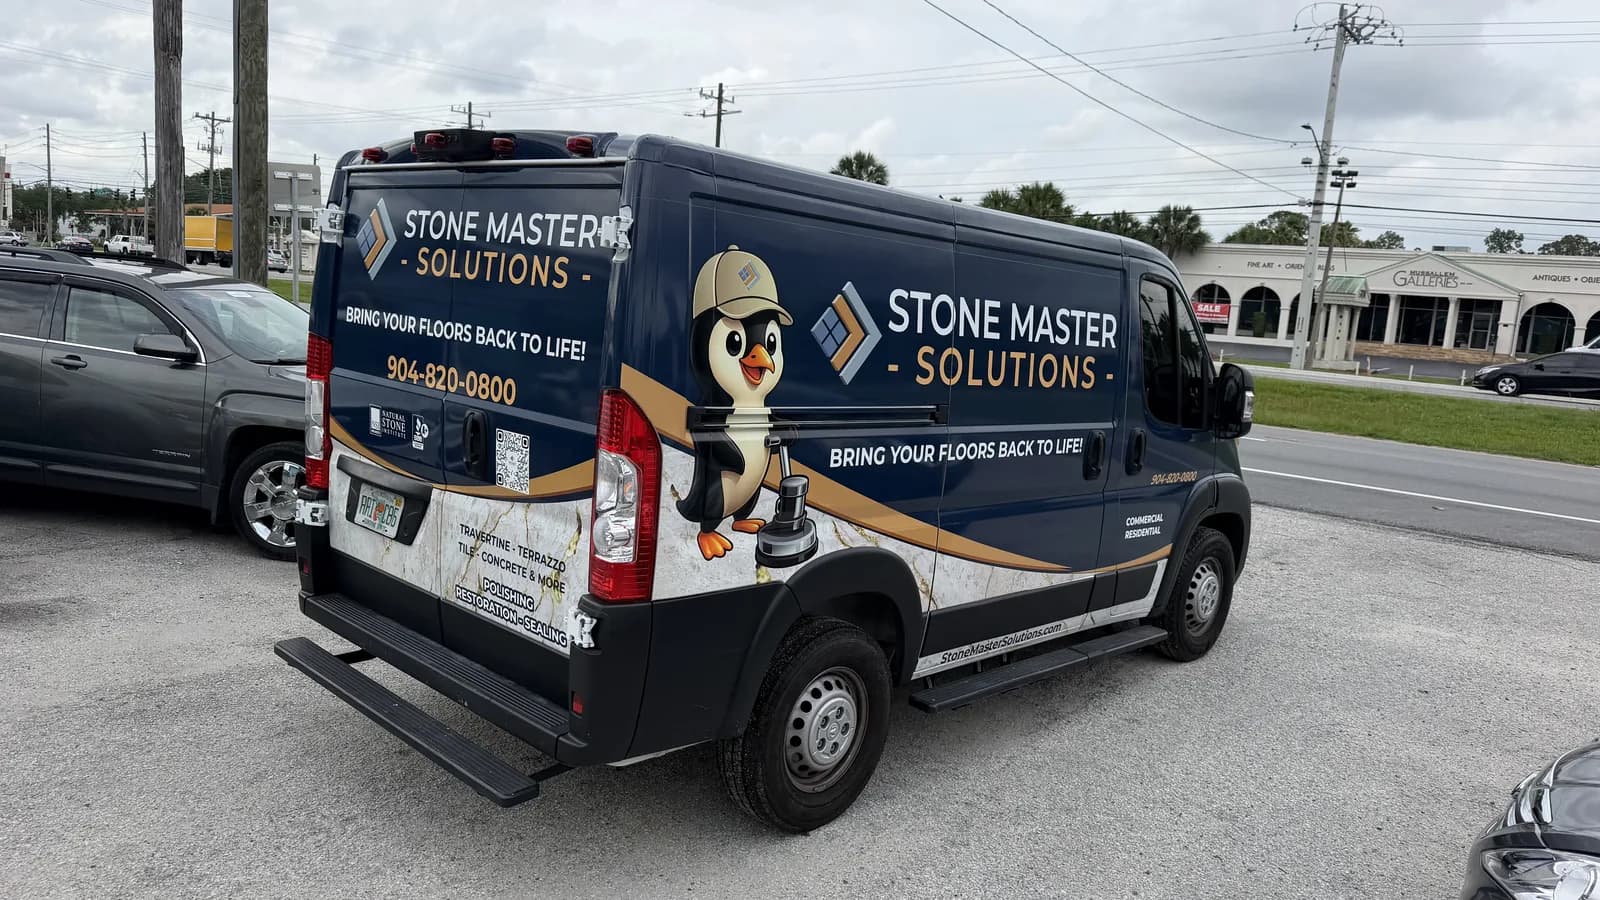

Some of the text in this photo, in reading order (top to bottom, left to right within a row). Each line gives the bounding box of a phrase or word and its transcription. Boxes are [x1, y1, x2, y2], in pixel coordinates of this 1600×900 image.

[404, 209, 599, 249] STONE MASTER
[416, 246, 570, 289] SOLUTIONS
[1393, 270, 1458, 288] GALLERIES
[888, 288, 1117, 349] STONE MASTER
[1197, 304, 1221, 313] SALE
[346, 306, 586, 361] BRING YOUR FLOORS BACK TO LIFE!
[387, 354, 517, 406] 904-820-0800
[916, 345, 1096, 390] SOLUTIONS
[382, 417, 406, 433] STONE
[829, 437, 1083, 468] BRING YOUR FLOORS BACK TO LIFE!
[1150, 471, 1197, 485] 904-820-0800
[1125, 526, 1161, 540] RESIDENTIAL
[1126, 513, 1164, 527] COMMERCIAL
[458, 541, 475, 557] TILE
[481, 551, 527, 579] CONCRETE
[529, 569, 536, 582] &
[538, 573, 566, 594] MORE
[460, 524, 511, 553] TRAVERTINE
[517, 545, 566, 573] TERRAZZO
[483, 577, 535, 612] POLISHING
[455, 584, 518, 625] RESTORATION
[523, 615, 568, 648] SEALING
[940, 623, 1062, 664] StoneMasterSolutions.com
